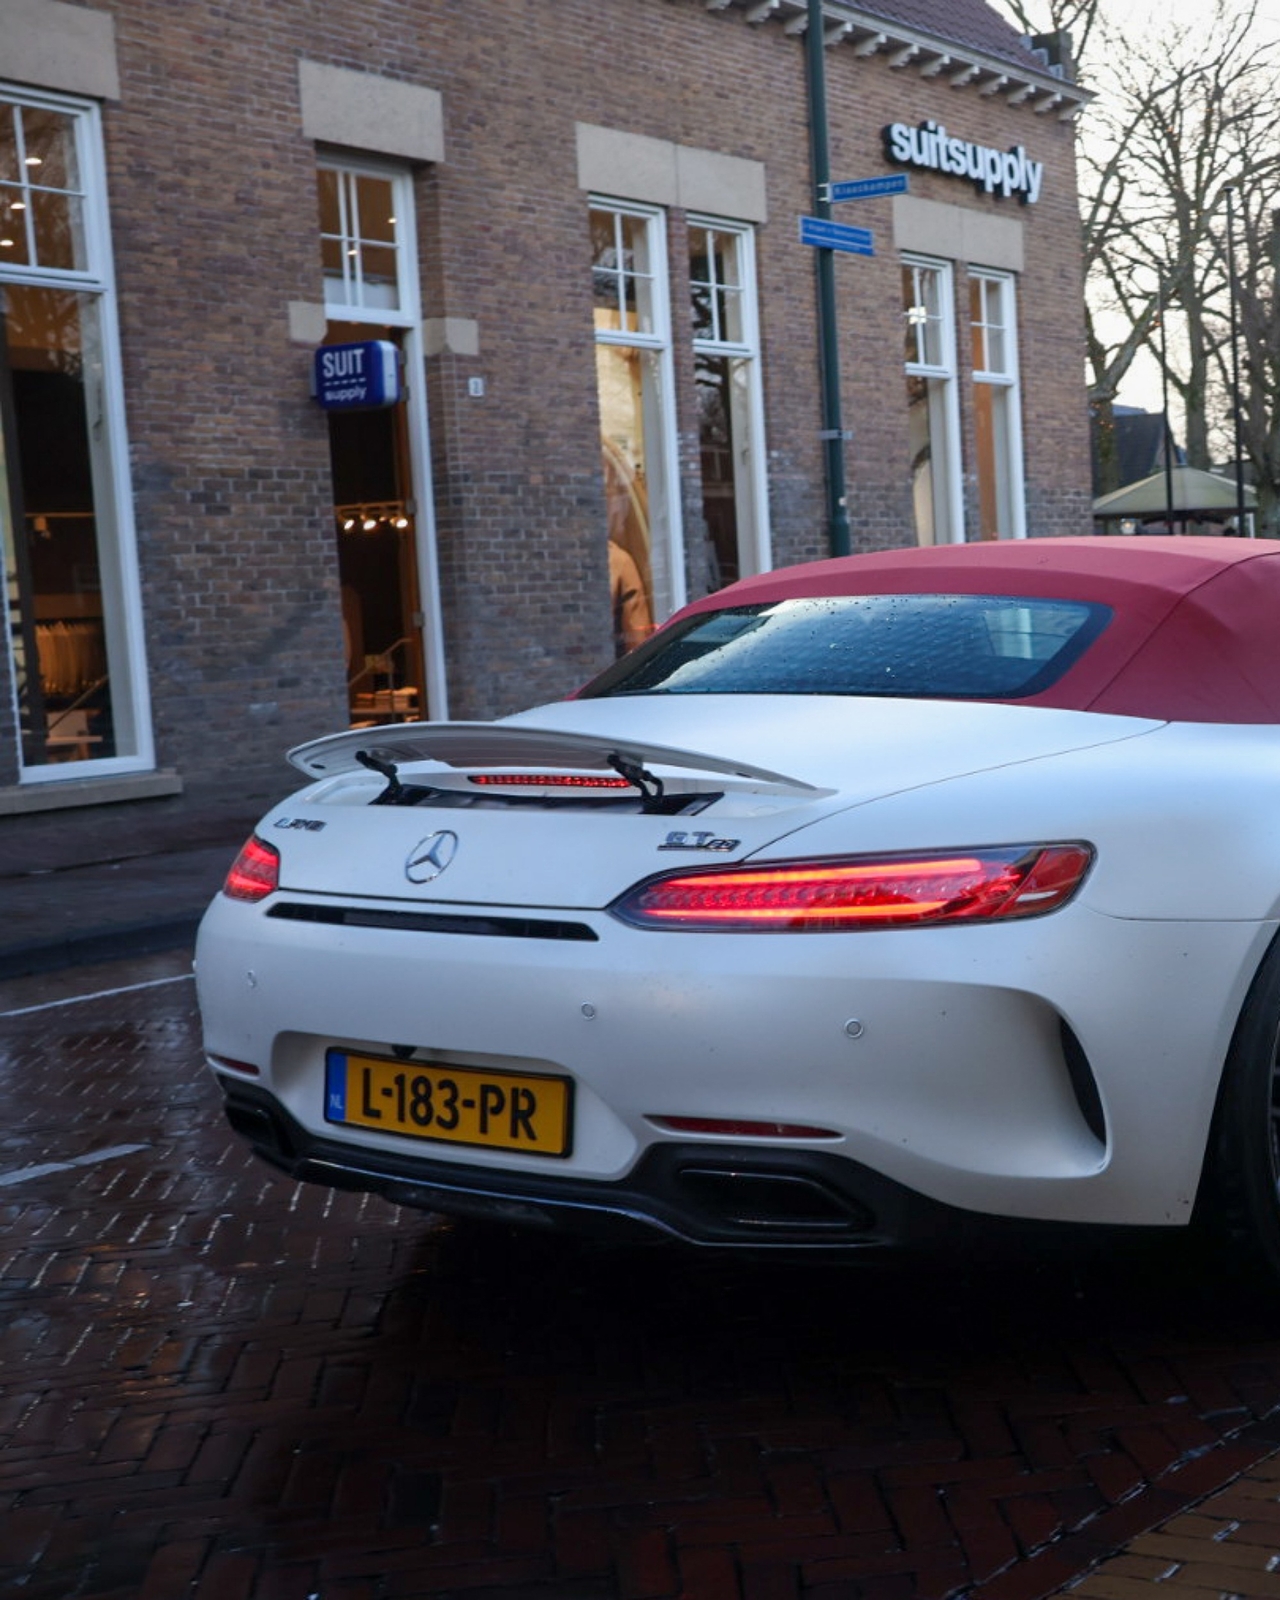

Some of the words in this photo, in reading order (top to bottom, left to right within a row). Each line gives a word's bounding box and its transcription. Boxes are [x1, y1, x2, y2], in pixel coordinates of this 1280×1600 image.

[889, 120, 1042, 203] suitsupply
[322, 348, 365, 378] SUIT
[324, 386, 367, 402] supply
[329, 1094, 343, 1109] NL
[362, 1067, 537, 1140] L-183-PR
